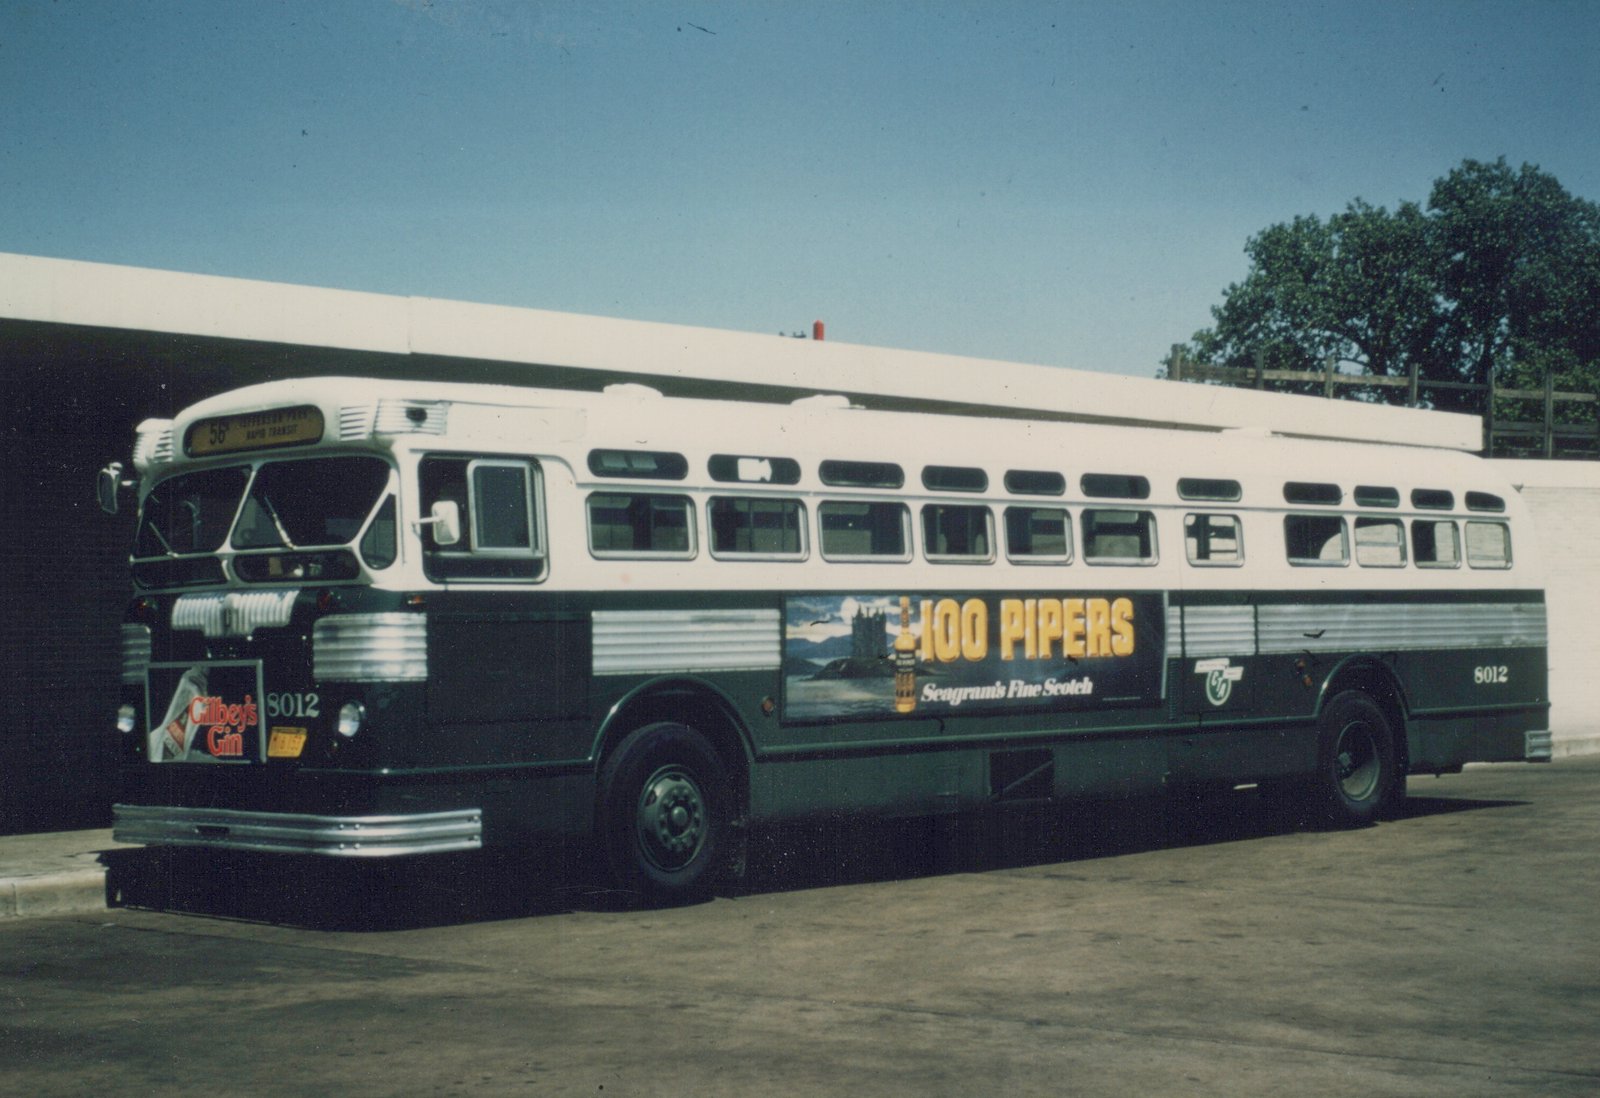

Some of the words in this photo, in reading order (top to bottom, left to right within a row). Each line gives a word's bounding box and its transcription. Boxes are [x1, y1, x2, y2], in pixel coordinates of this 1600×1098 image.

[268, 424, 298, 437] TRANSIT
[920, 598, 988, 663] 100
[1000, 597, 1135, 661] PIPERS
[1474, 666, 1508, 684] 8012
[267, 693, 319, 717] 8012
[921, 681, 1006, 706] Seagram's
[1006, 680, 1042, 698] Fine
[1042, 676, 1093, 697] Scotch
[189, 695, 258, 732] Gilbey's
[207, 726, 243, 757] Gin
